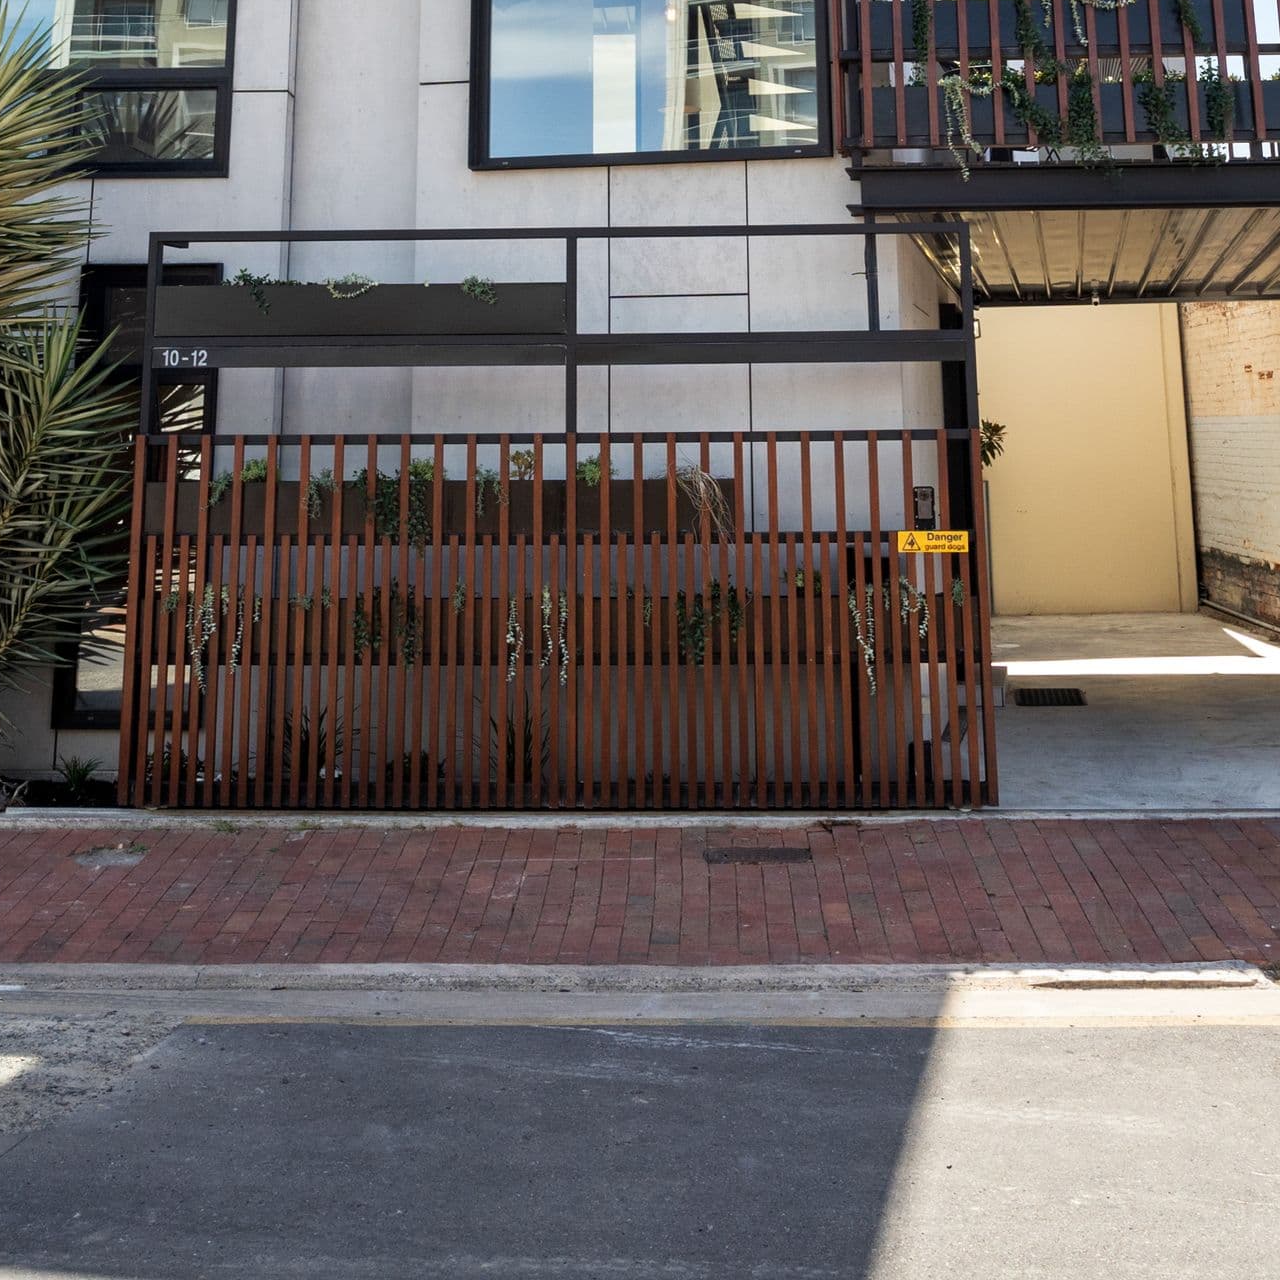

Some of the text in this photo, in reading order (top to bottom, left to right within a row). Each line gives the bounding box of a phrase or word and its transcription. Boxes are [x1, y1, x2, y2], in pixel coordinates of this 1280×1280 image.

[926, 532, 964, 543] Danger
[924, 543, 966, 551] guard dogs
